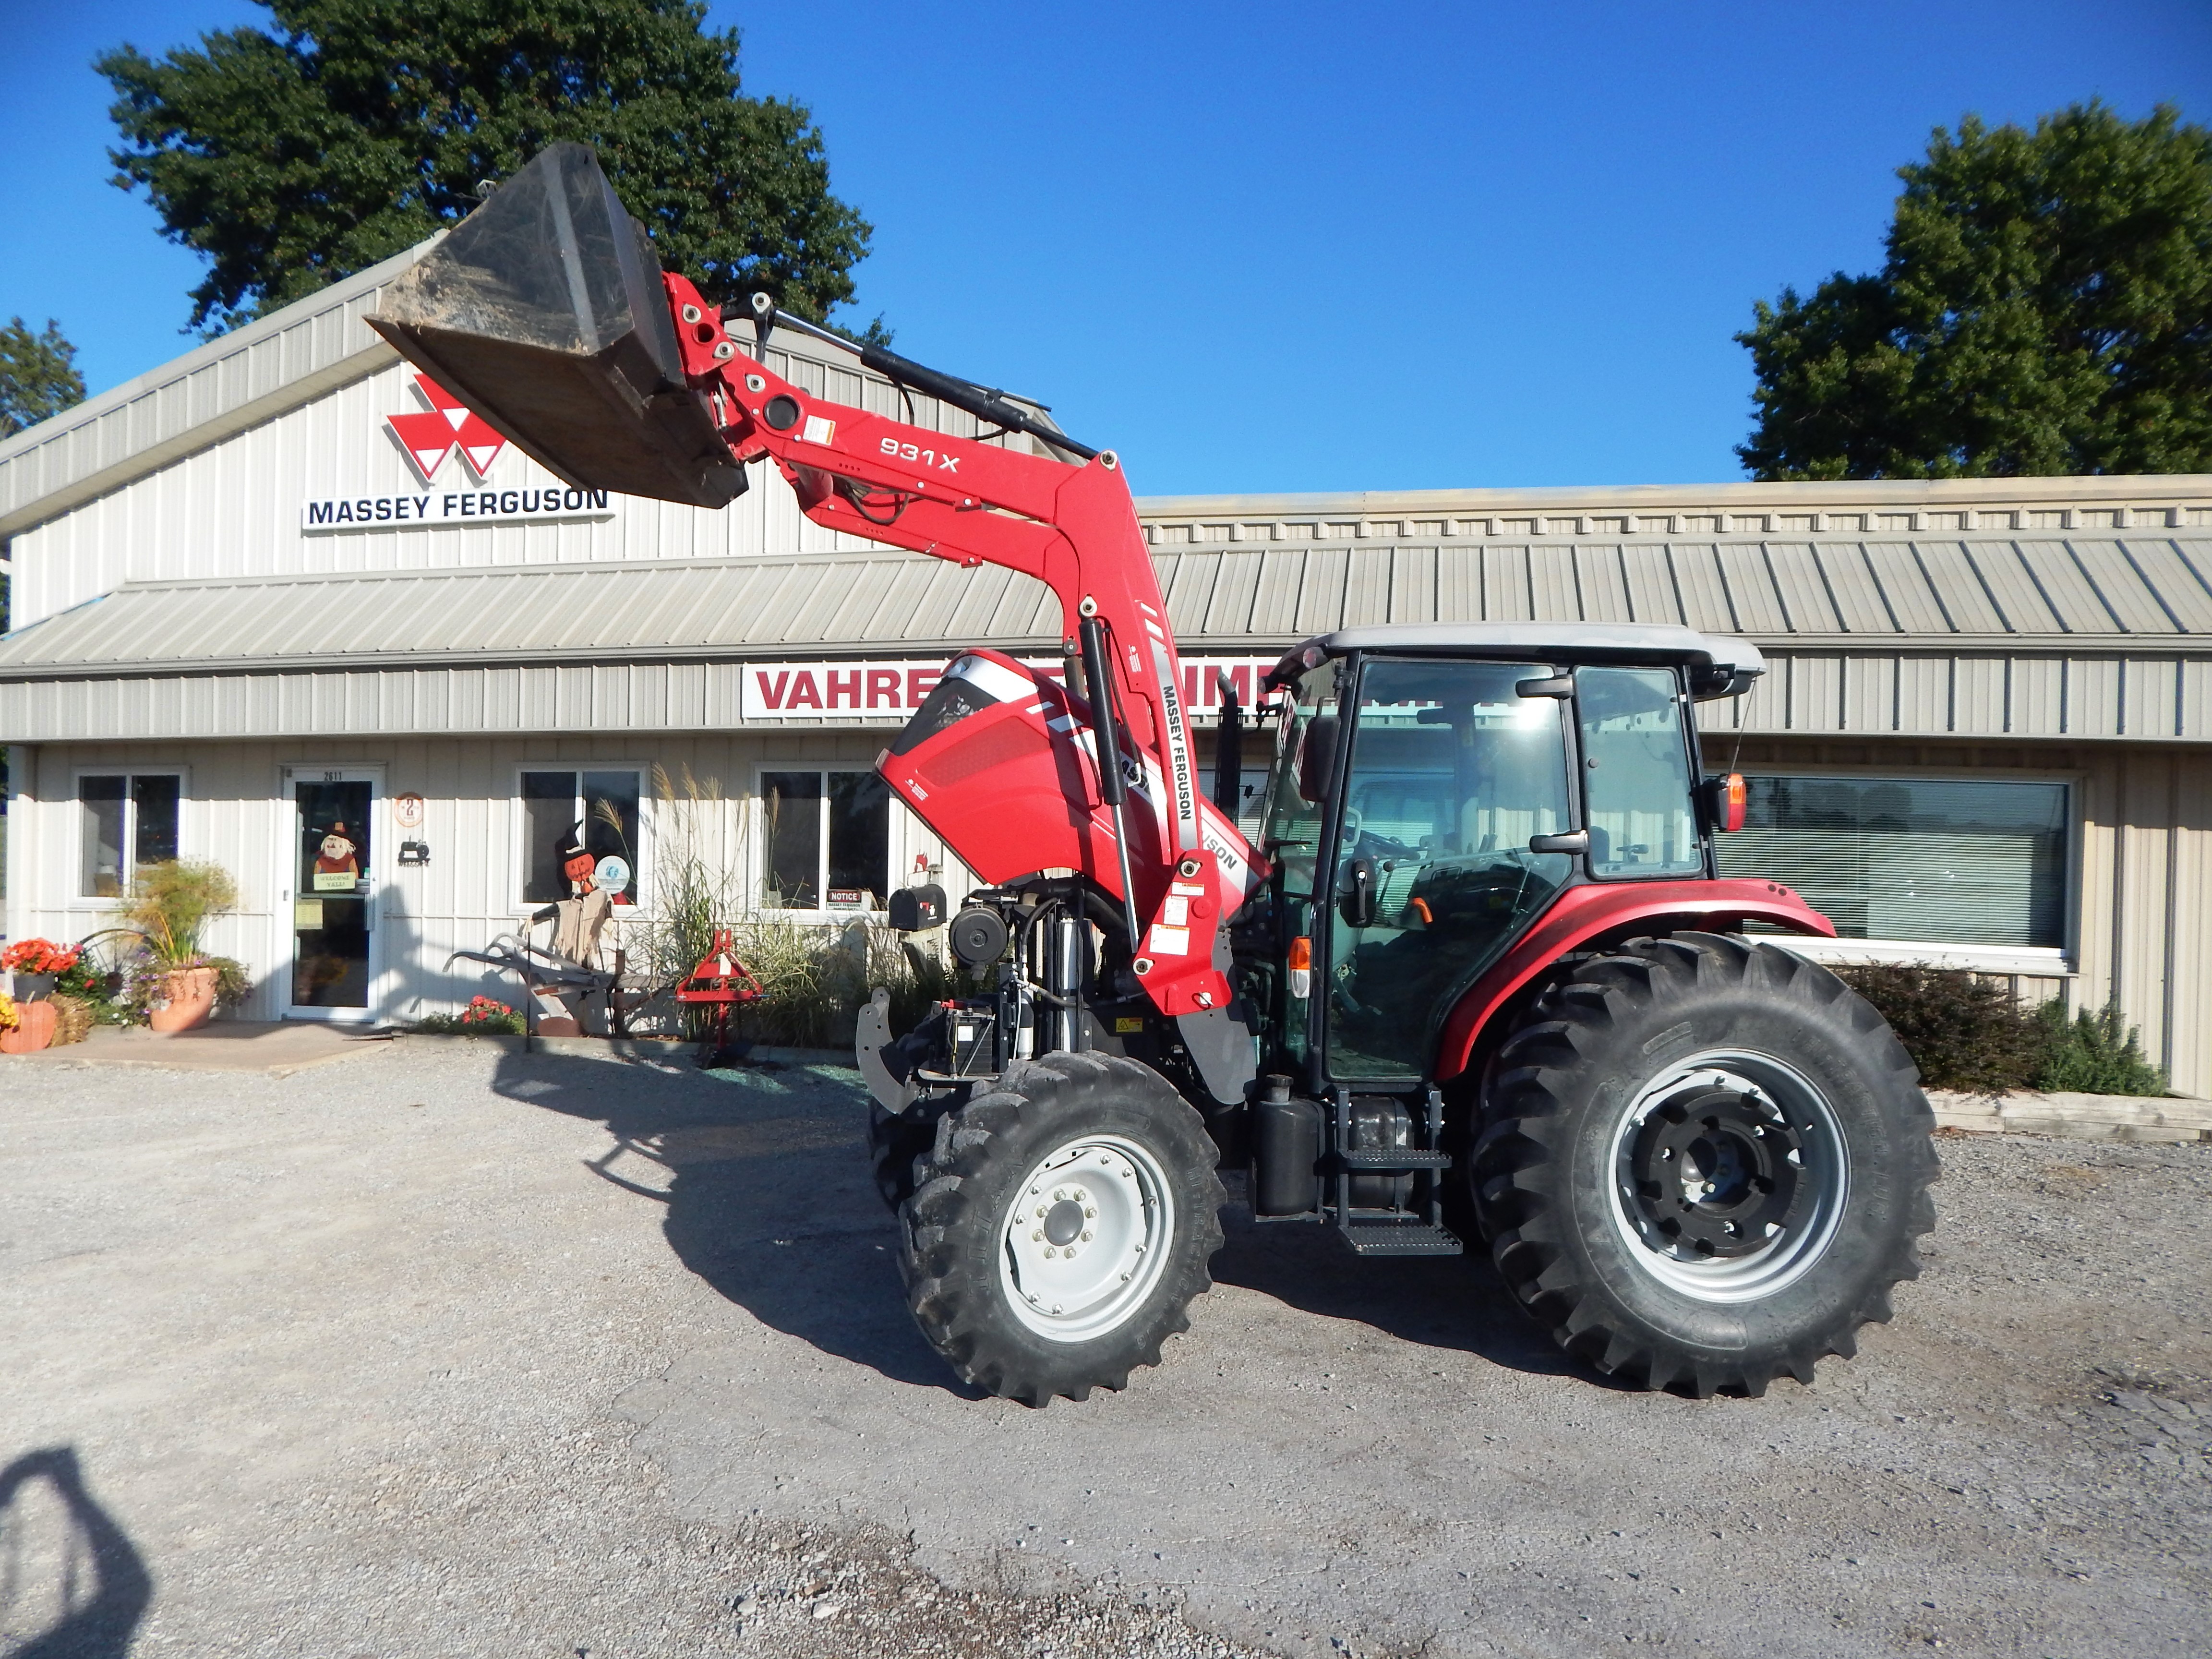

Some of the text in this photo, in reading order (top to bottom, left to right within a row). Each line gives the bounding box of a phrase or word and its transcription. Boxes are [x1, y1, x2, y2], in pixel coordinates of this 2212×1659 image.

[309, 488, 607, 524] MASSEY FERGUSON
[1163, 685, 1191, 820] MASSEY FERGUSON
[324, 771, 342, 781] 2611
[831, 892, 858, 901] NOTICE
